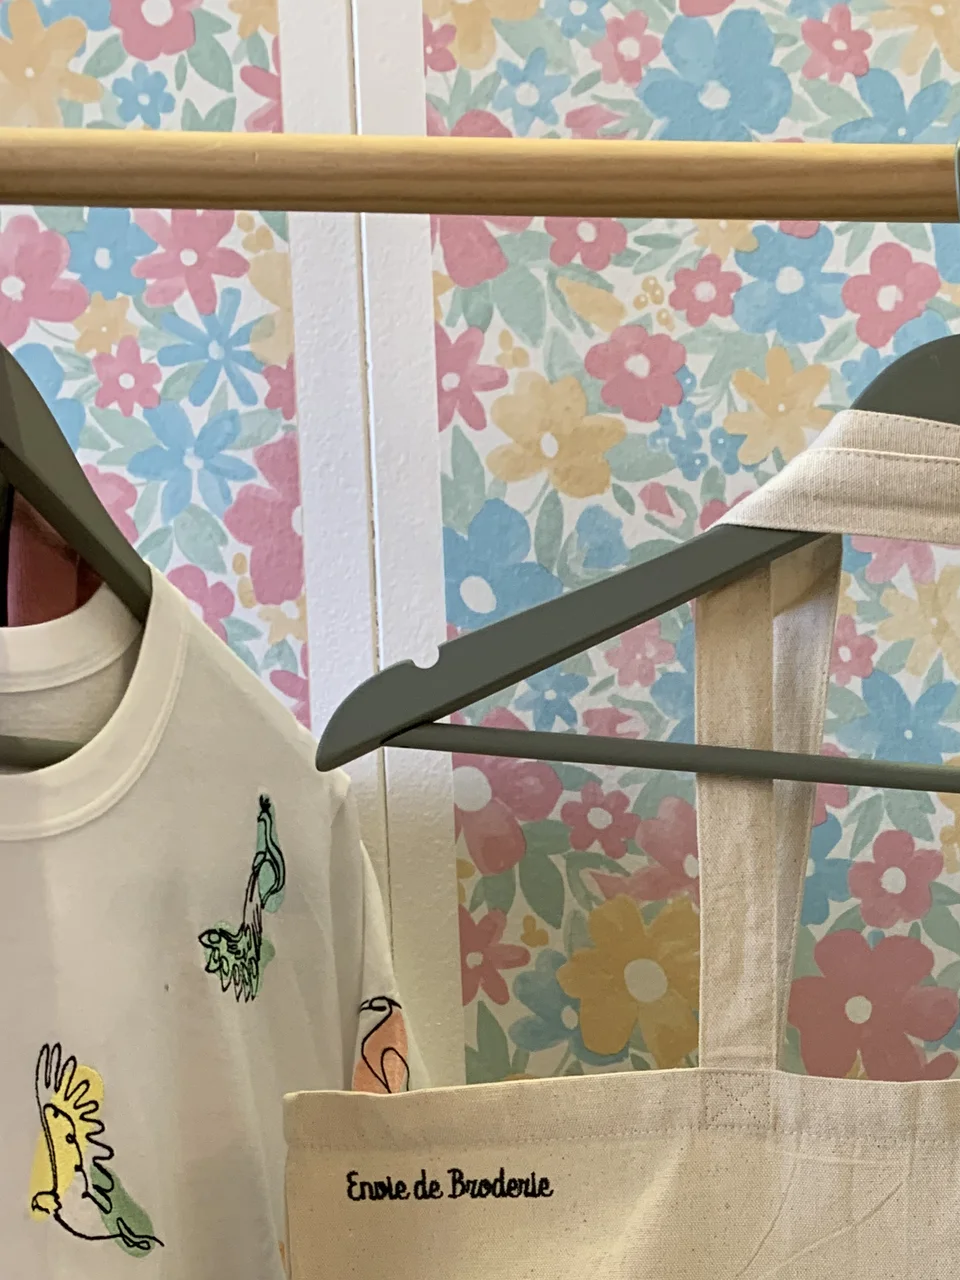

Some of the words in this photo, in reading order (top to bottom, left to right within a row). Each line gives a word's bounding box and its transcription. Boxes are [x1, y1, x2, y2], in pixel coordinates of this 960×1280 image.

[346, 1170, 410, 1201] Envie
[413, 1169, 444, 1200] de
[447, 1167, 554, 1199] Broderie
